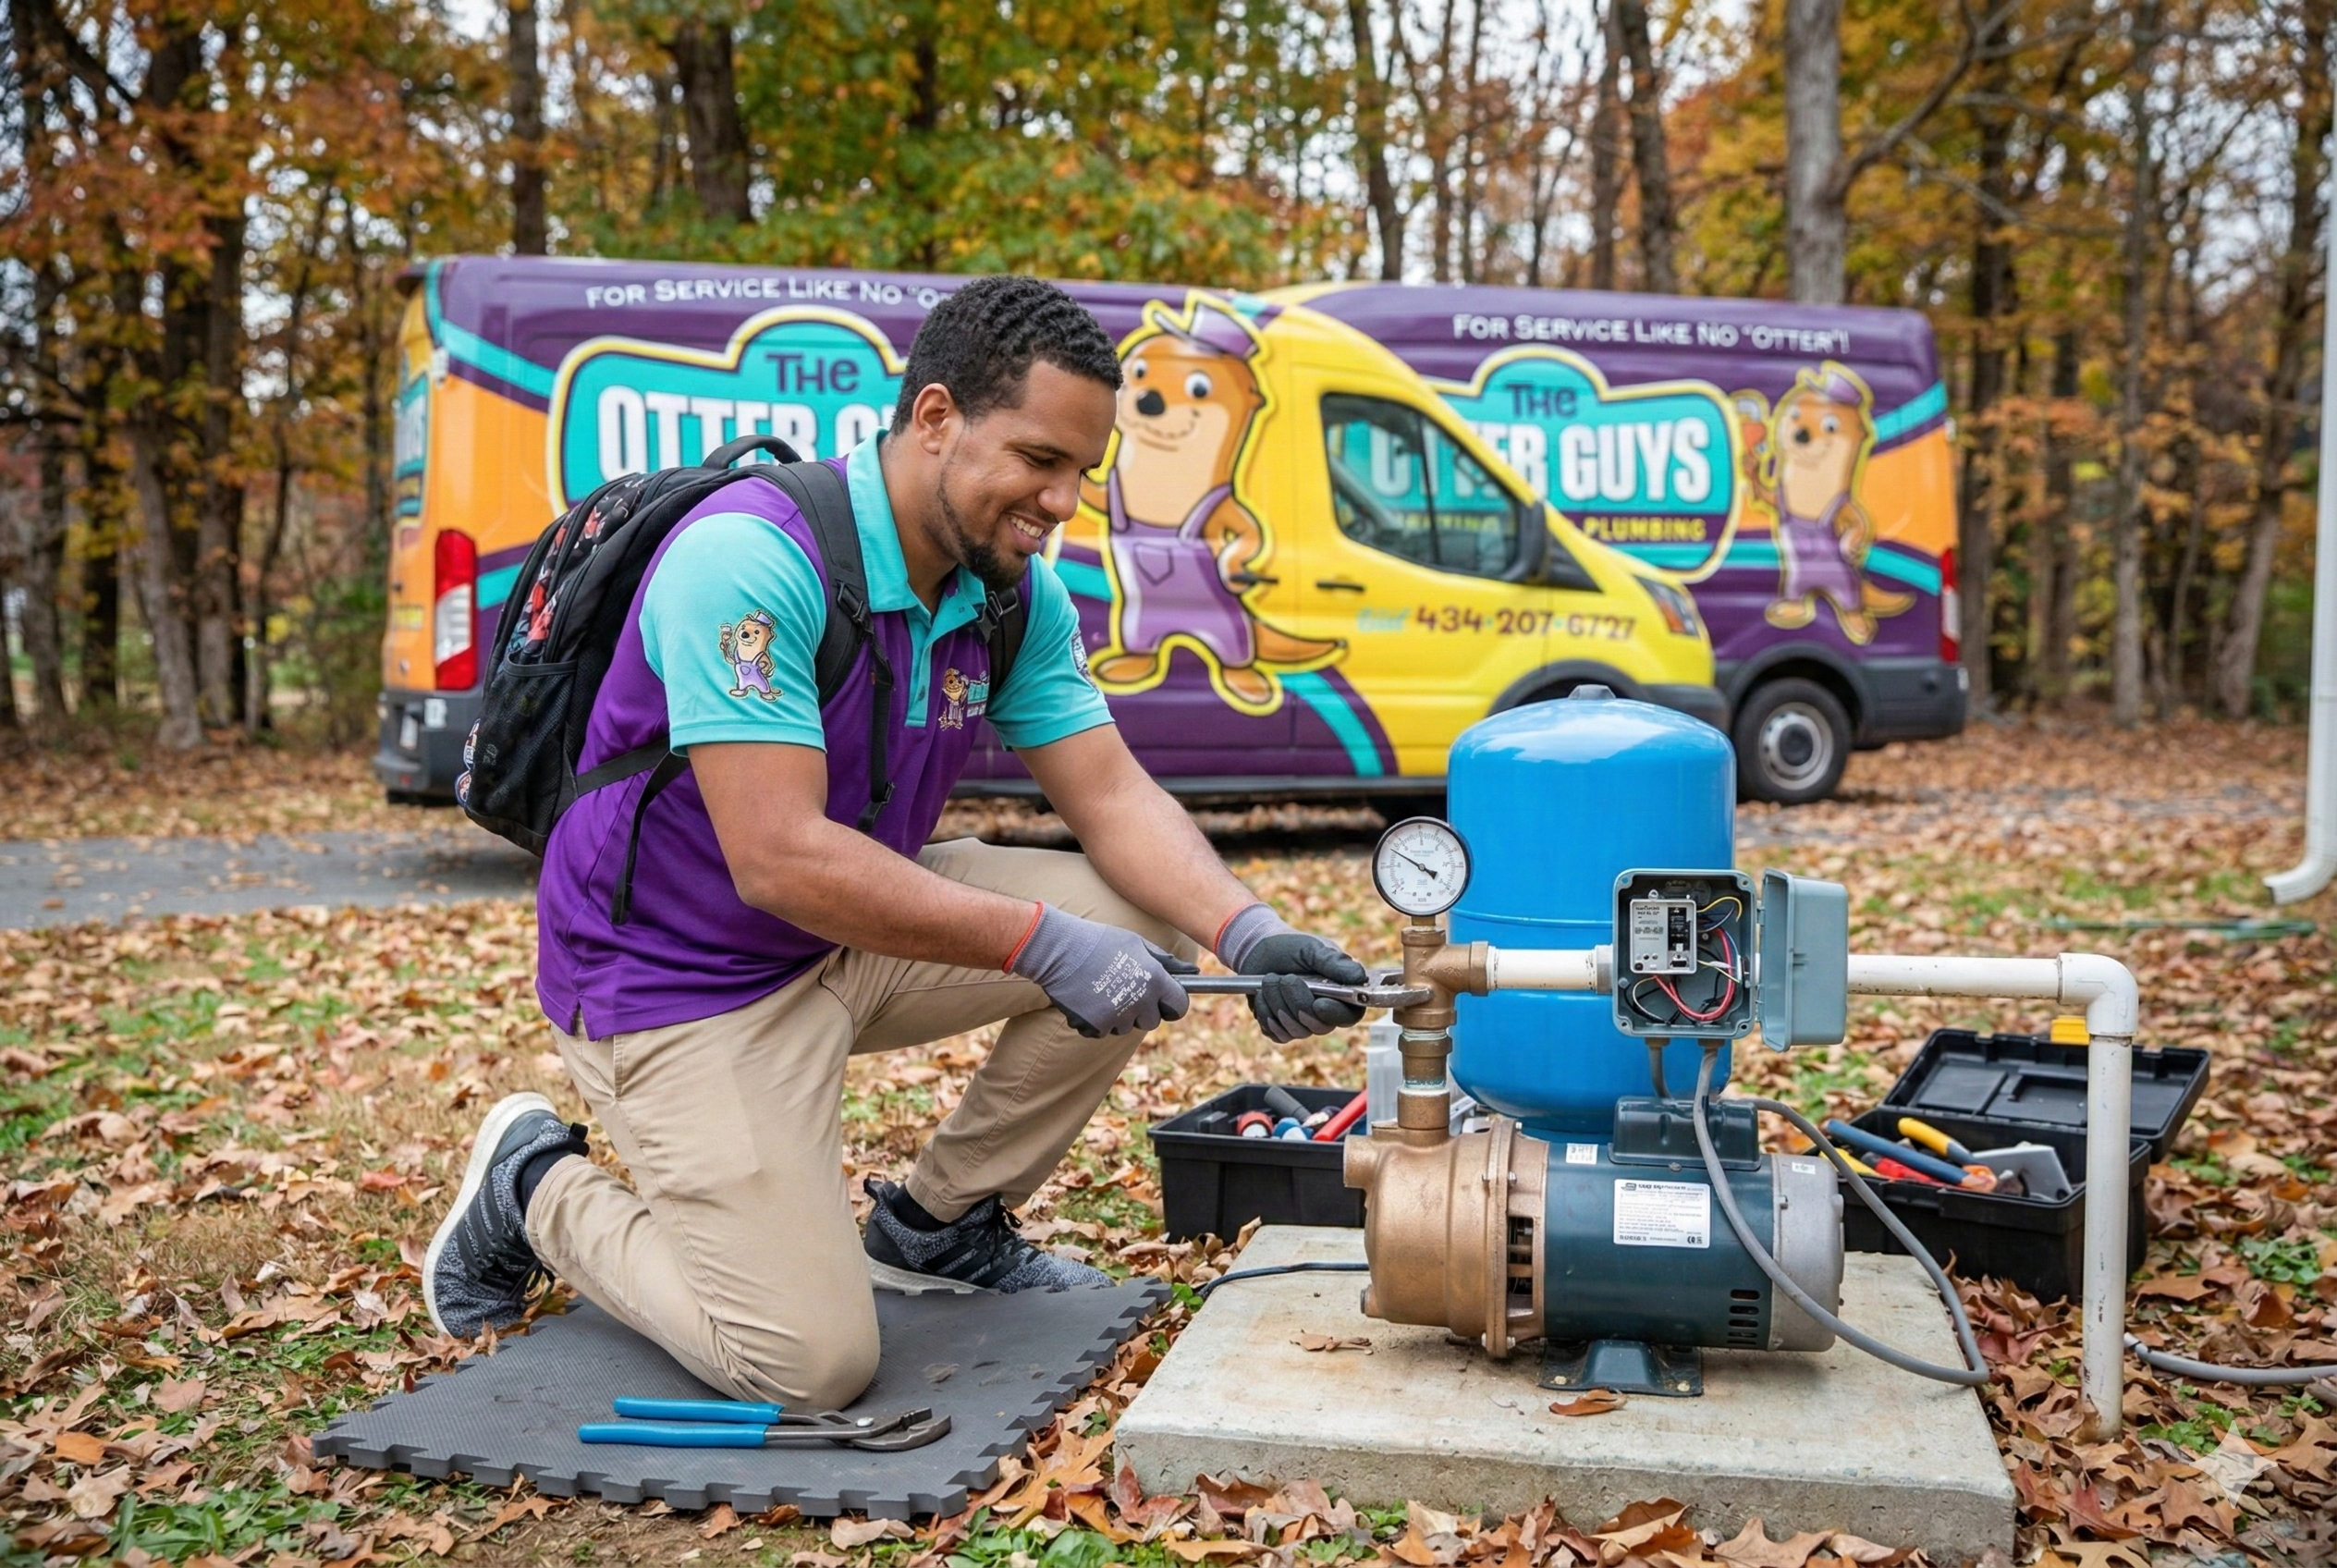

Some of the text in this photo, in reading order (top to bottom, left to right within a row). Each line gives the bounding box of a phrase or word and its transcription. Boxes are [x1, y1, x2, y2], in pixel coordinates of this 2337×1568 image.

[585, 284, 645, 309] FOR
[655, 278, 779, 301] SERVICE
[788, 276, 851, 301] LIKE
[860, 281, 902, 305] NO
[1452, 313, 1510, 339] FOR
[1513, 315, 1628, 342] SERVICE
[1634, 317, 1694, 345] LIKE
[1697, 321, 1739, 347] NO
[1559, 417, 1711, 503] GUYS
[1583, 517, 1707, 542] PLUMBING
